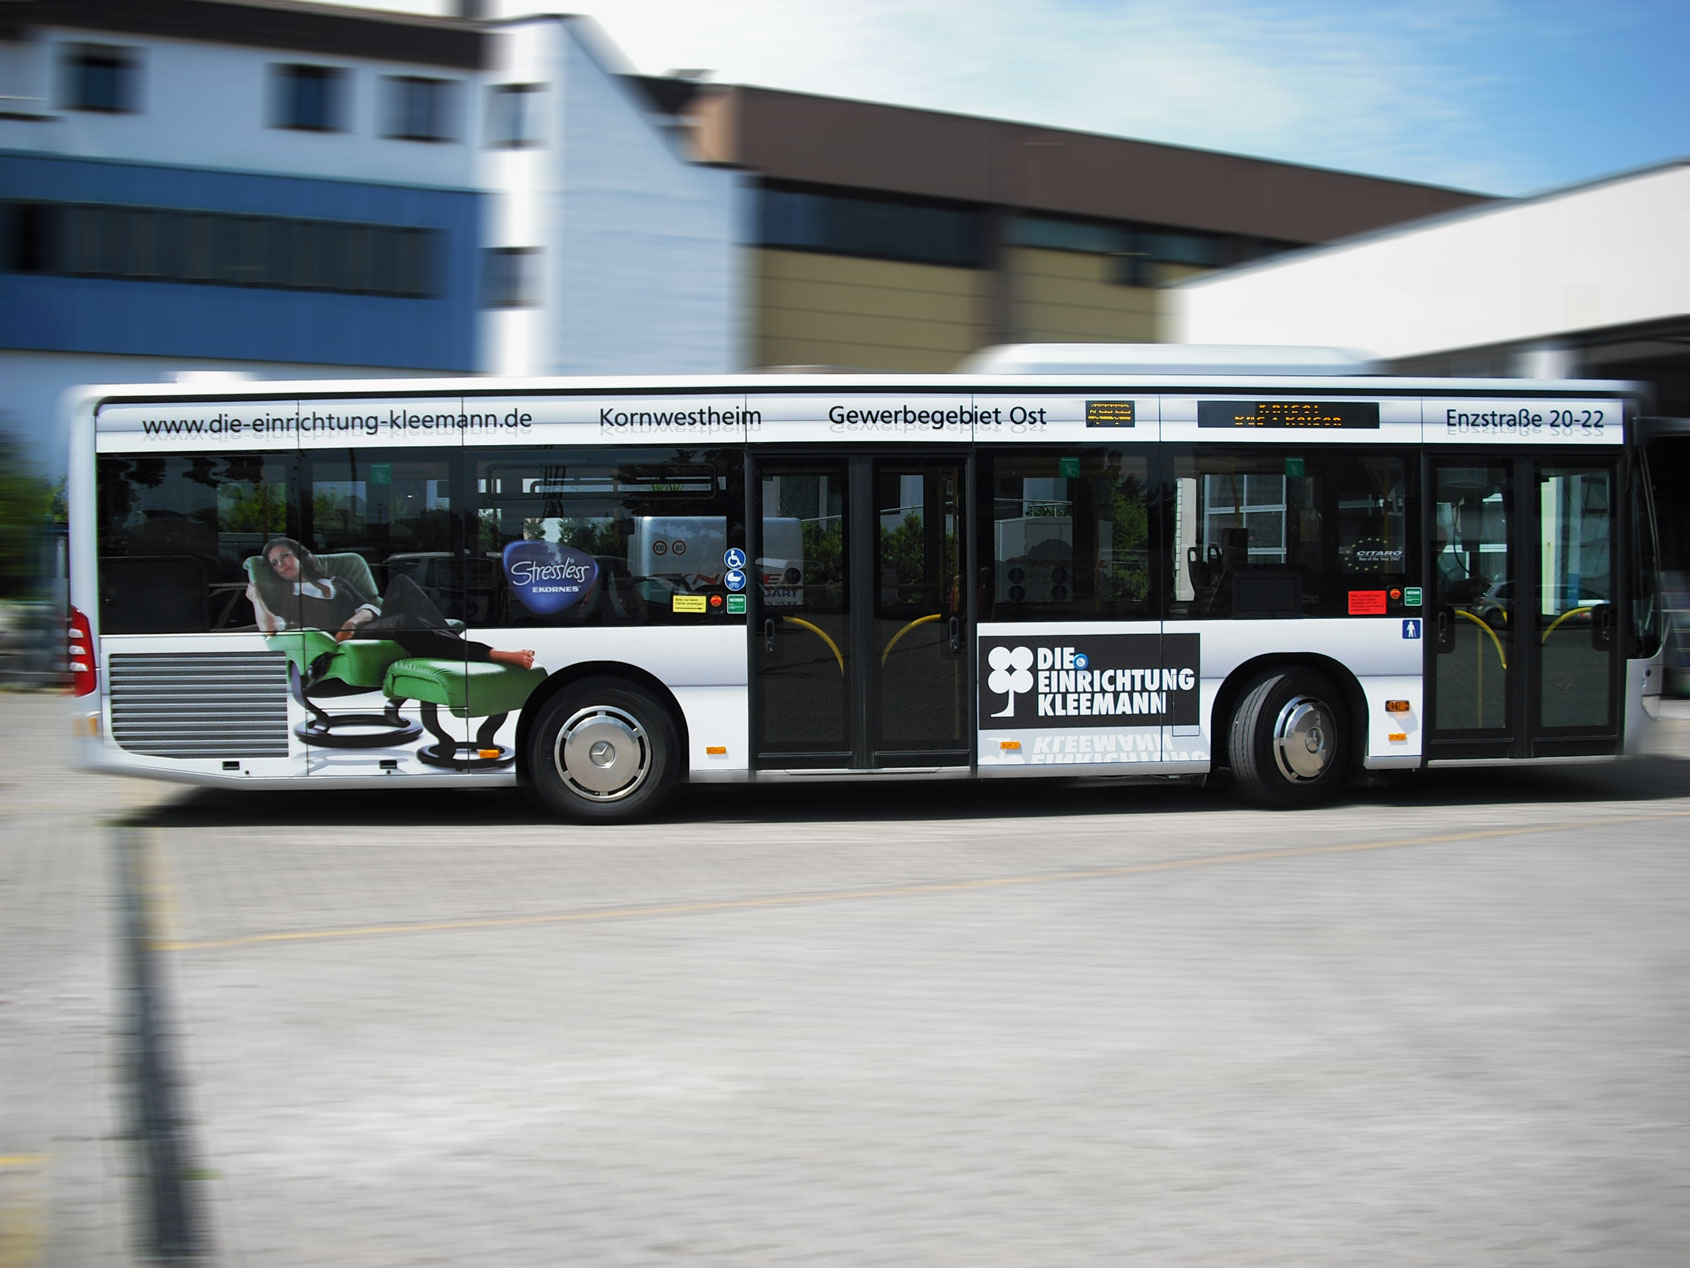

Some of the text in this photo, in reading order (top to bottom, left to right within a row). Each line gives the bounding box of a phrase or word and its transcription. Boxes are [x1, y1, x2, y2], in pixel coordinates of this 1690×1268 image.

[142, 405, 1605, 436] www.die-einrichtung-kleemann.de Kornwestheim Gewerbegebiet Ost Enzstraße 20-22
[511, 557, 590, 586] Stressless
[532, 585, 580, 593] EKORNES
[1037, 647, 1076, 670] DIE
[1038, 668, 1196, 693] EINRICHTUNG
[1038, 692, 1167, 717] KLEEMANN
